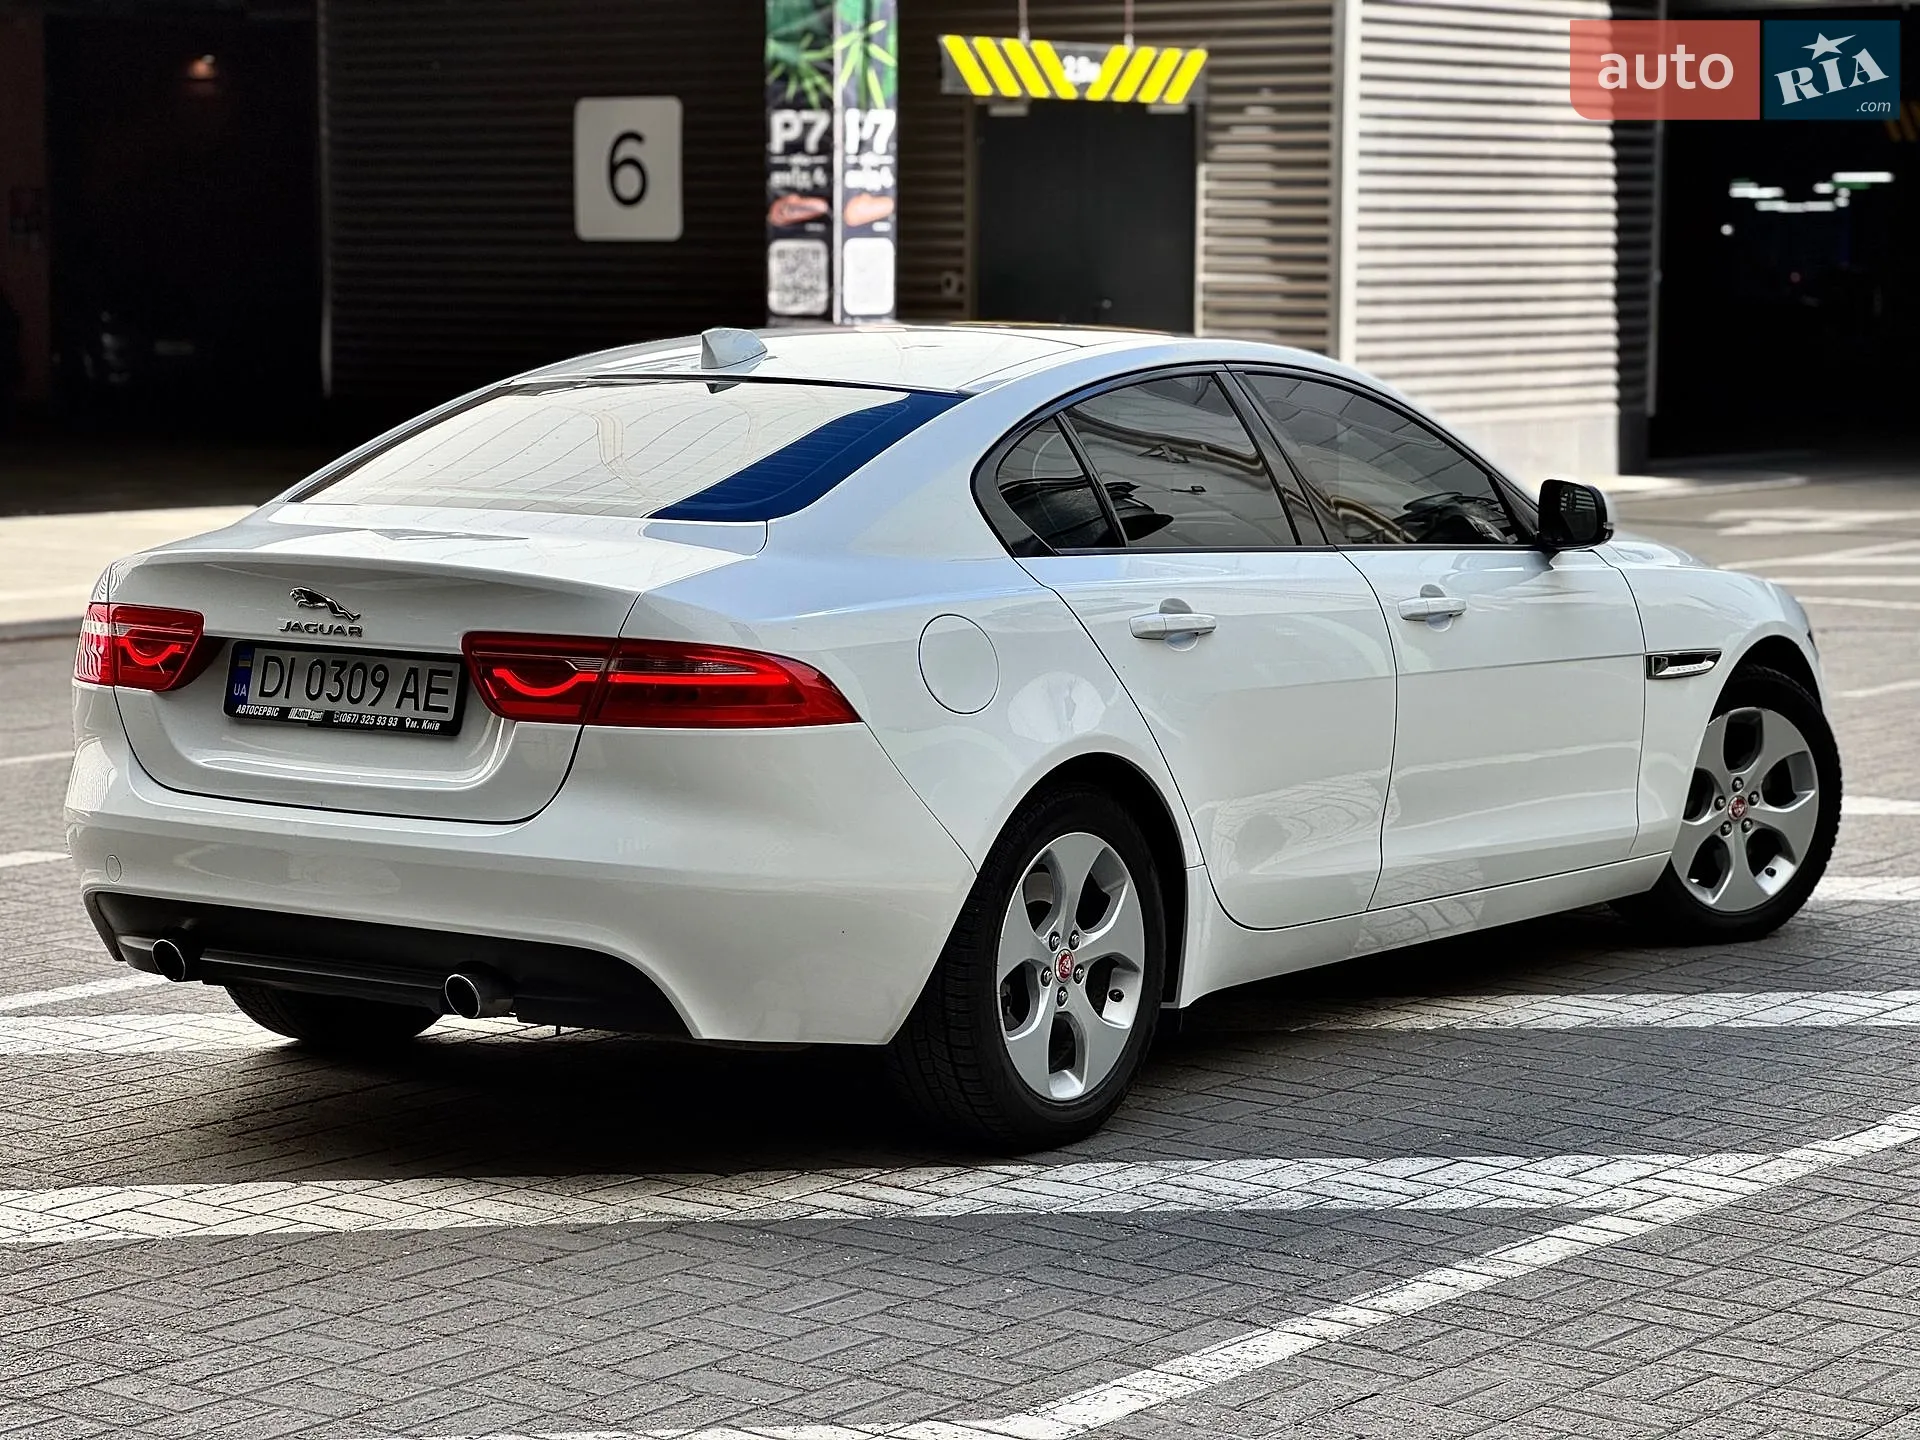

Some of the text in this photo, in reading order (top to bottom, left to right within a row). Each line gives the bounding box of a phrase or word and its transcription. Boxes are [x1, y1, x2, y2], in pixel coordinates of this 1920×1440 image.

[769, 109, 831, 155] P7
[608, 130, 648, 207] 6
[279, 619, 364, 638] JAGUAR
[233, 683, 248, 698] UA
[258, 654, 454, 714] DI 0309 AE
[235, 704, 280, 717] АВТОСЕРВІС
[339, 712, 360, 724] (067)
[360, 714, 376, 725] 325
[376, 715, 387, 726] 93
[387, 717, 399, 727] 93
[421, 719, 441, 731] Київ
